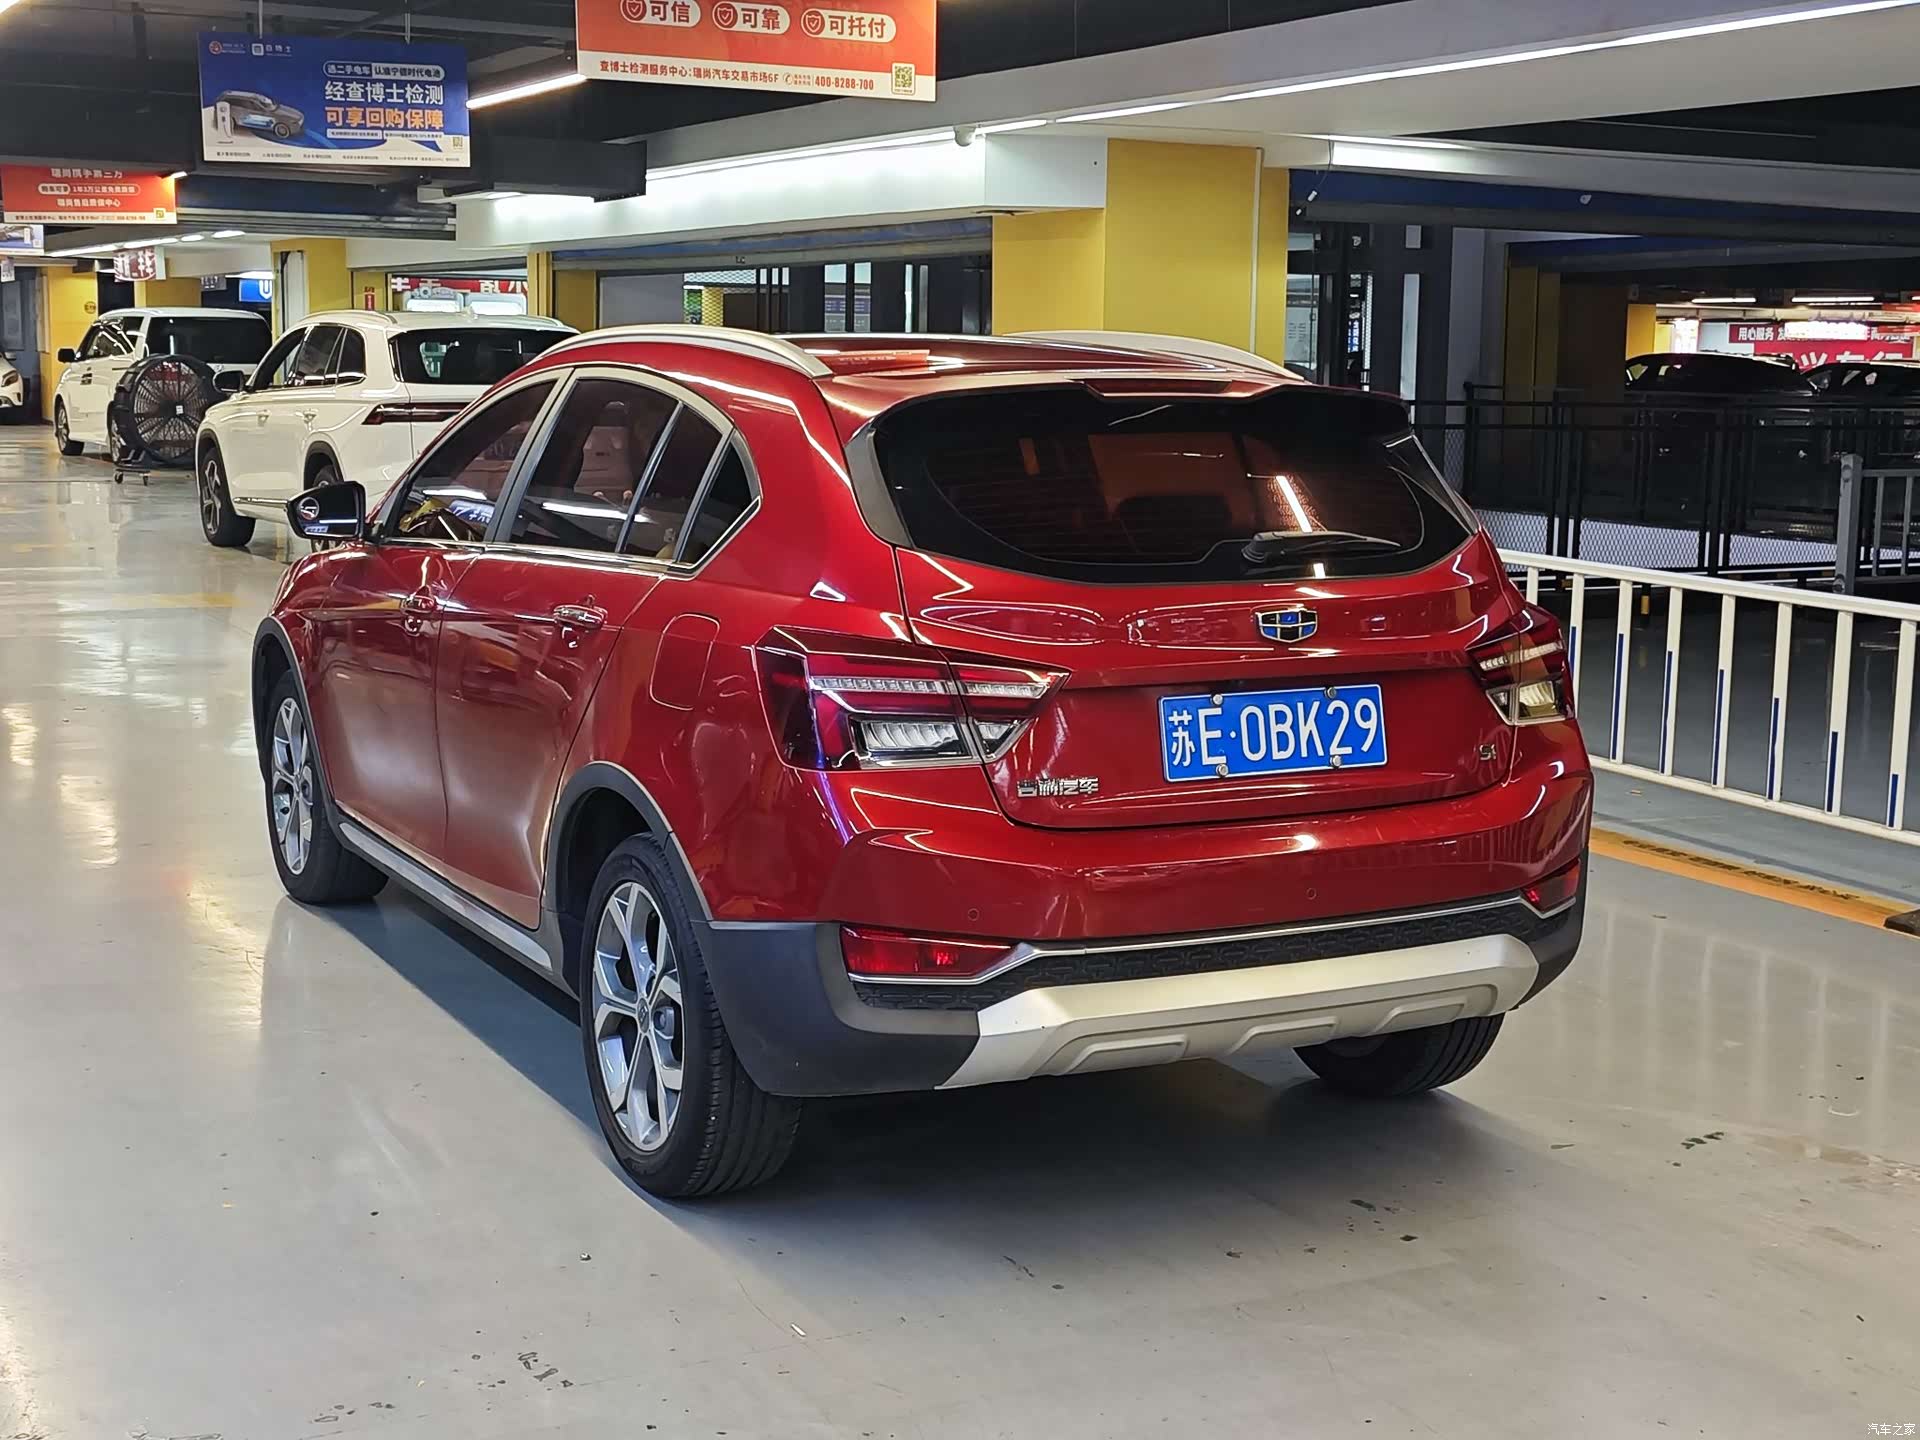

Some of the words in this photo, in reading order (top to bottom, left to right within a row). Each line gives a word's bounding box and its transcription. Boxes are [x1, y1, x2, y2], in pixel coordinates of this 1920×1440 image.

[650, 1, 690, 24] 可信
[741, 8, 781, 31] 可靠
[828, 14, 886, 40] 可托付
[324, 80, 444, 106] 经查博士检测
[324, 106, 444, 130] 可享回购保障
